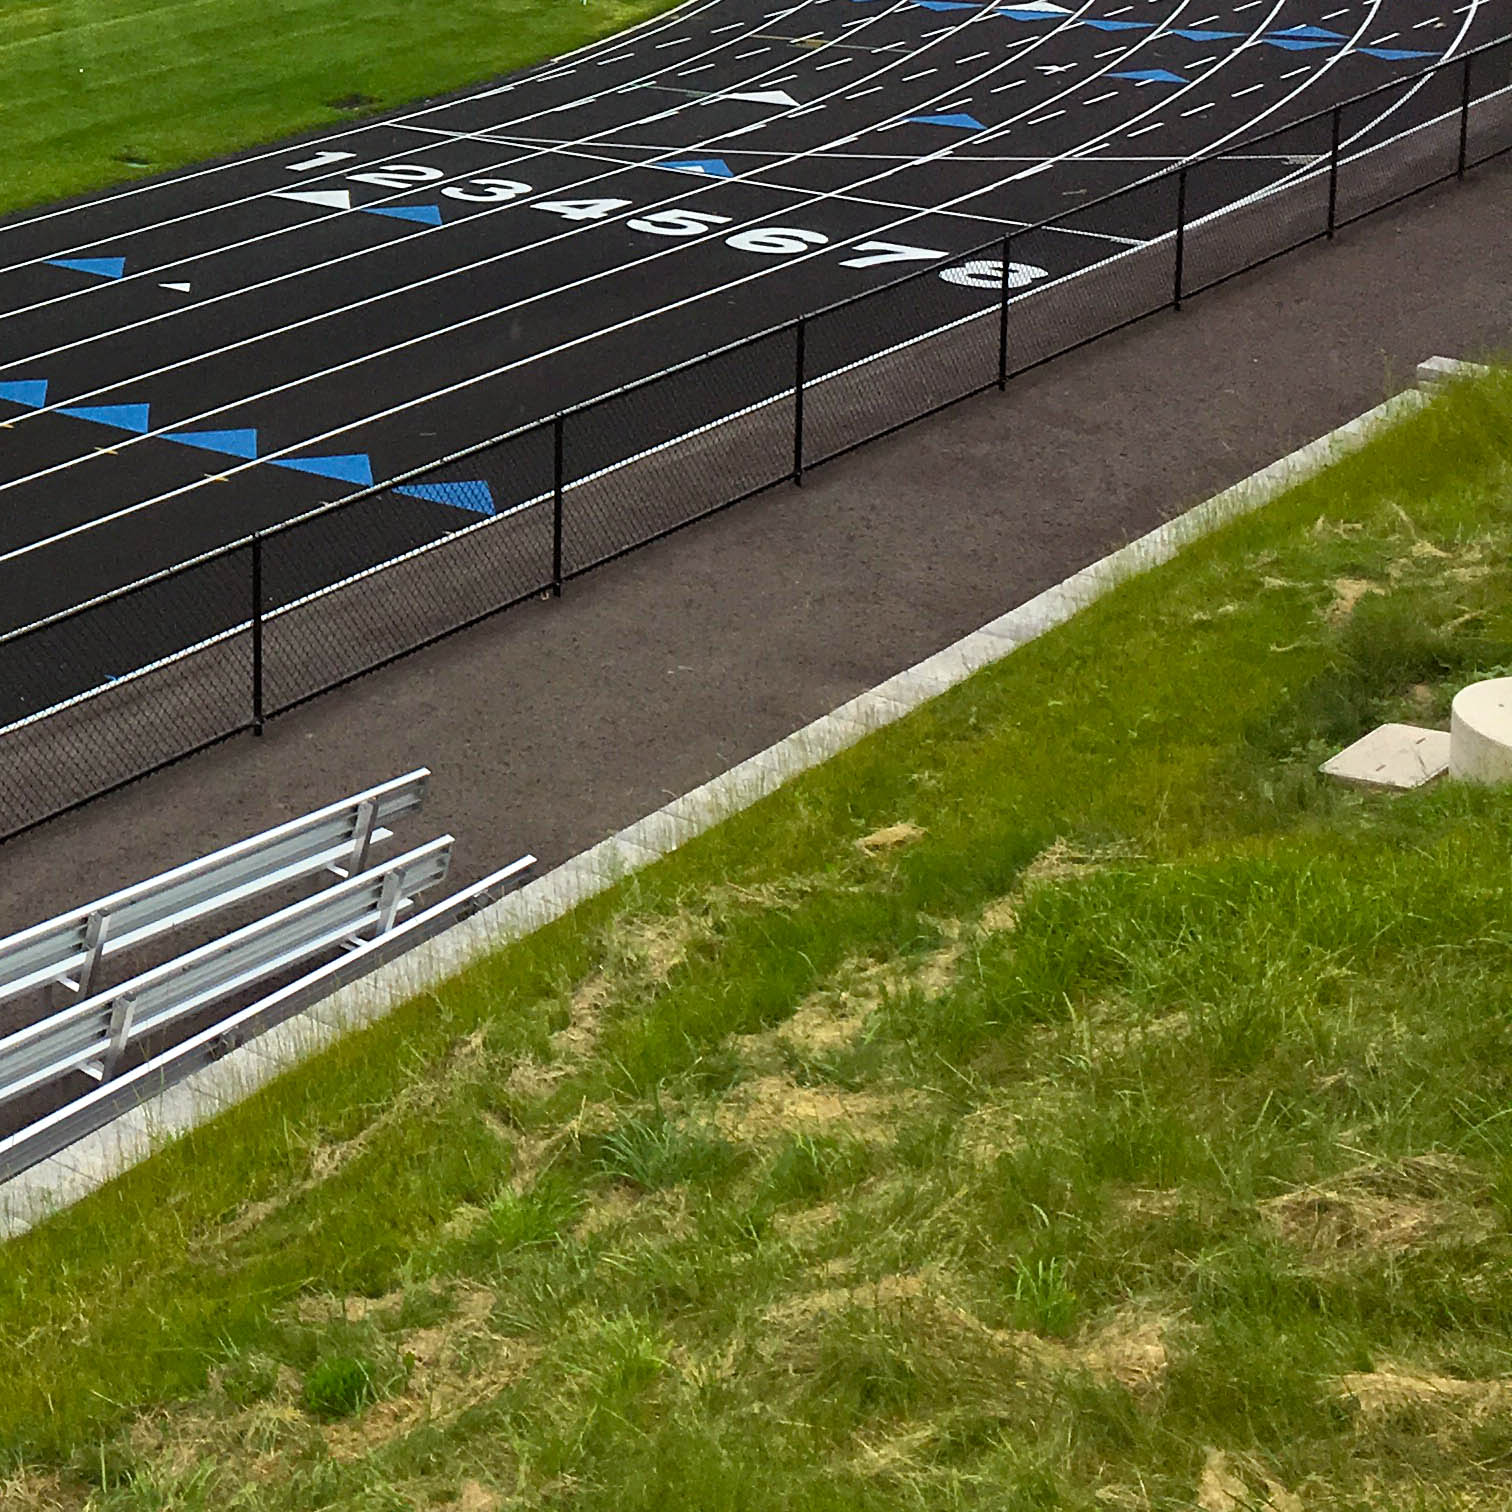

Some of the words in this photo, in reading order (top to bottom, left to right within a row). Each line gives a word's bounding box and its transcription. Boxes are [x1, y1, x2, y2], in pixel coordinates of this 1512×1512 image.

[285, 151, 357, 171] 1
[345, 164, 444, 189] 2
[441, 179, 533, 202] 3
[530, 198, 633, 221] 4
[626, 209, 734, 237] 5
[725, 227, 830, 255] 6
[837, 241, 950, 269] 7
[938, 260, 1050, 290] 8
